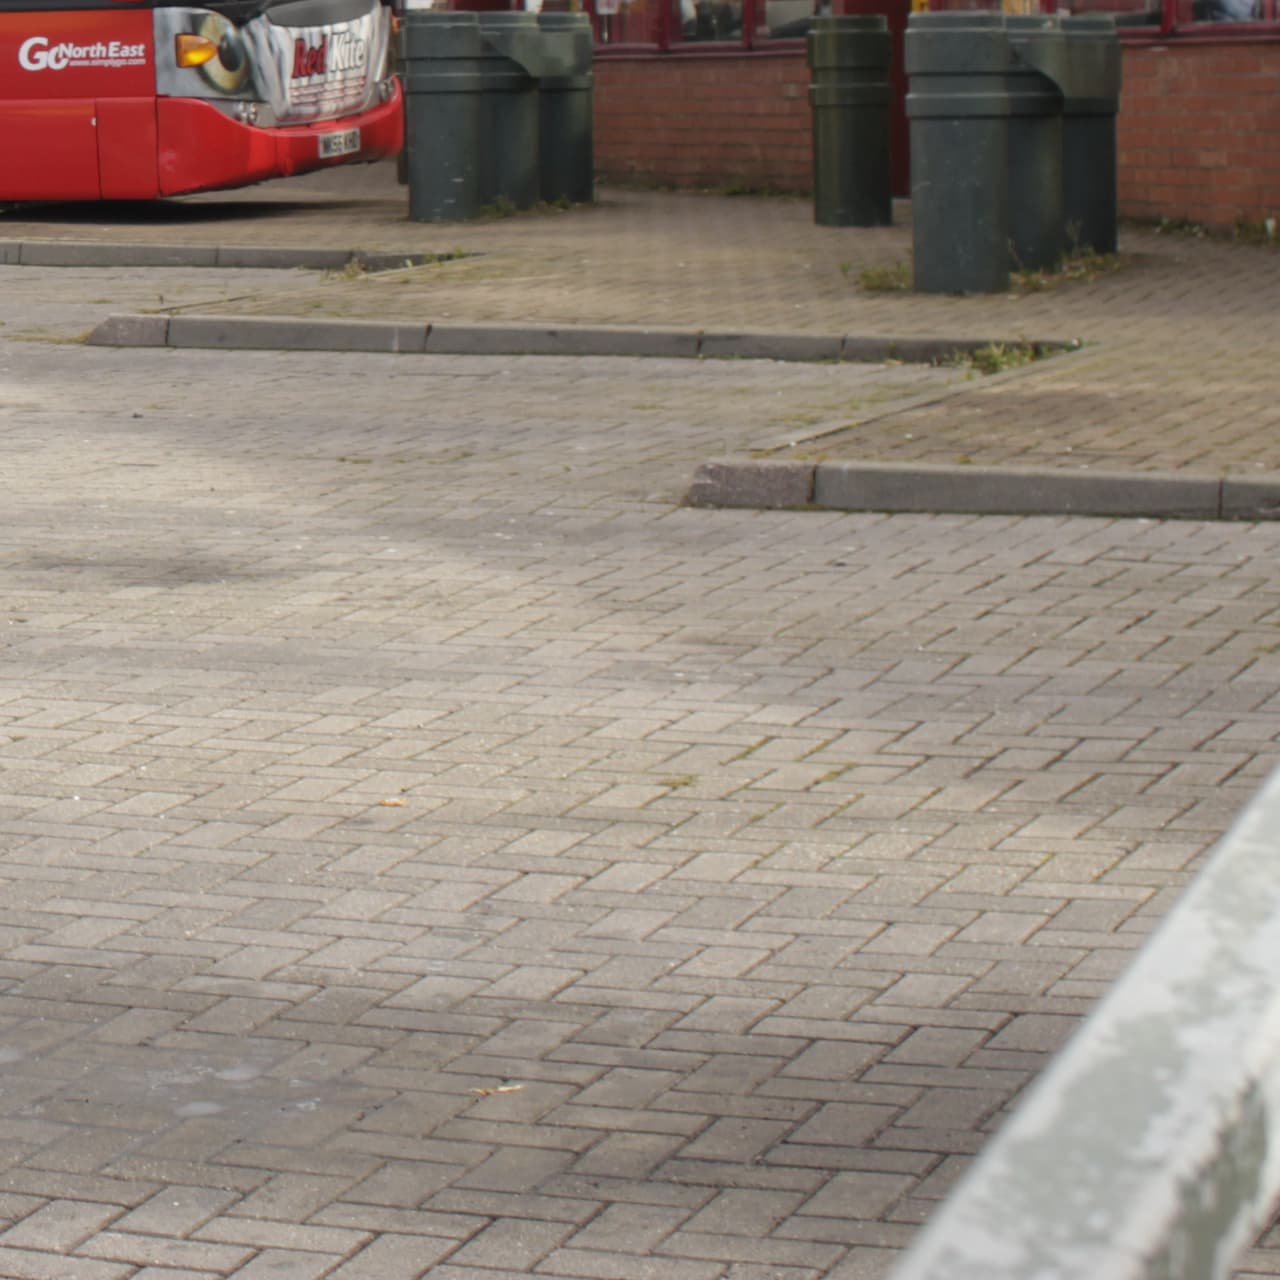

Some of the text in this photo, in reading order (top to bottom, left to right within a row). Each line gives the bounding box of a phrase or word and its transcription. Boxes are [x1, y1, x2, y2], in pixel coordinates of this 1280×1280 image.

[18, 36, 145, 71] Go North East
[291, 31, 365, 78] Red Kite
